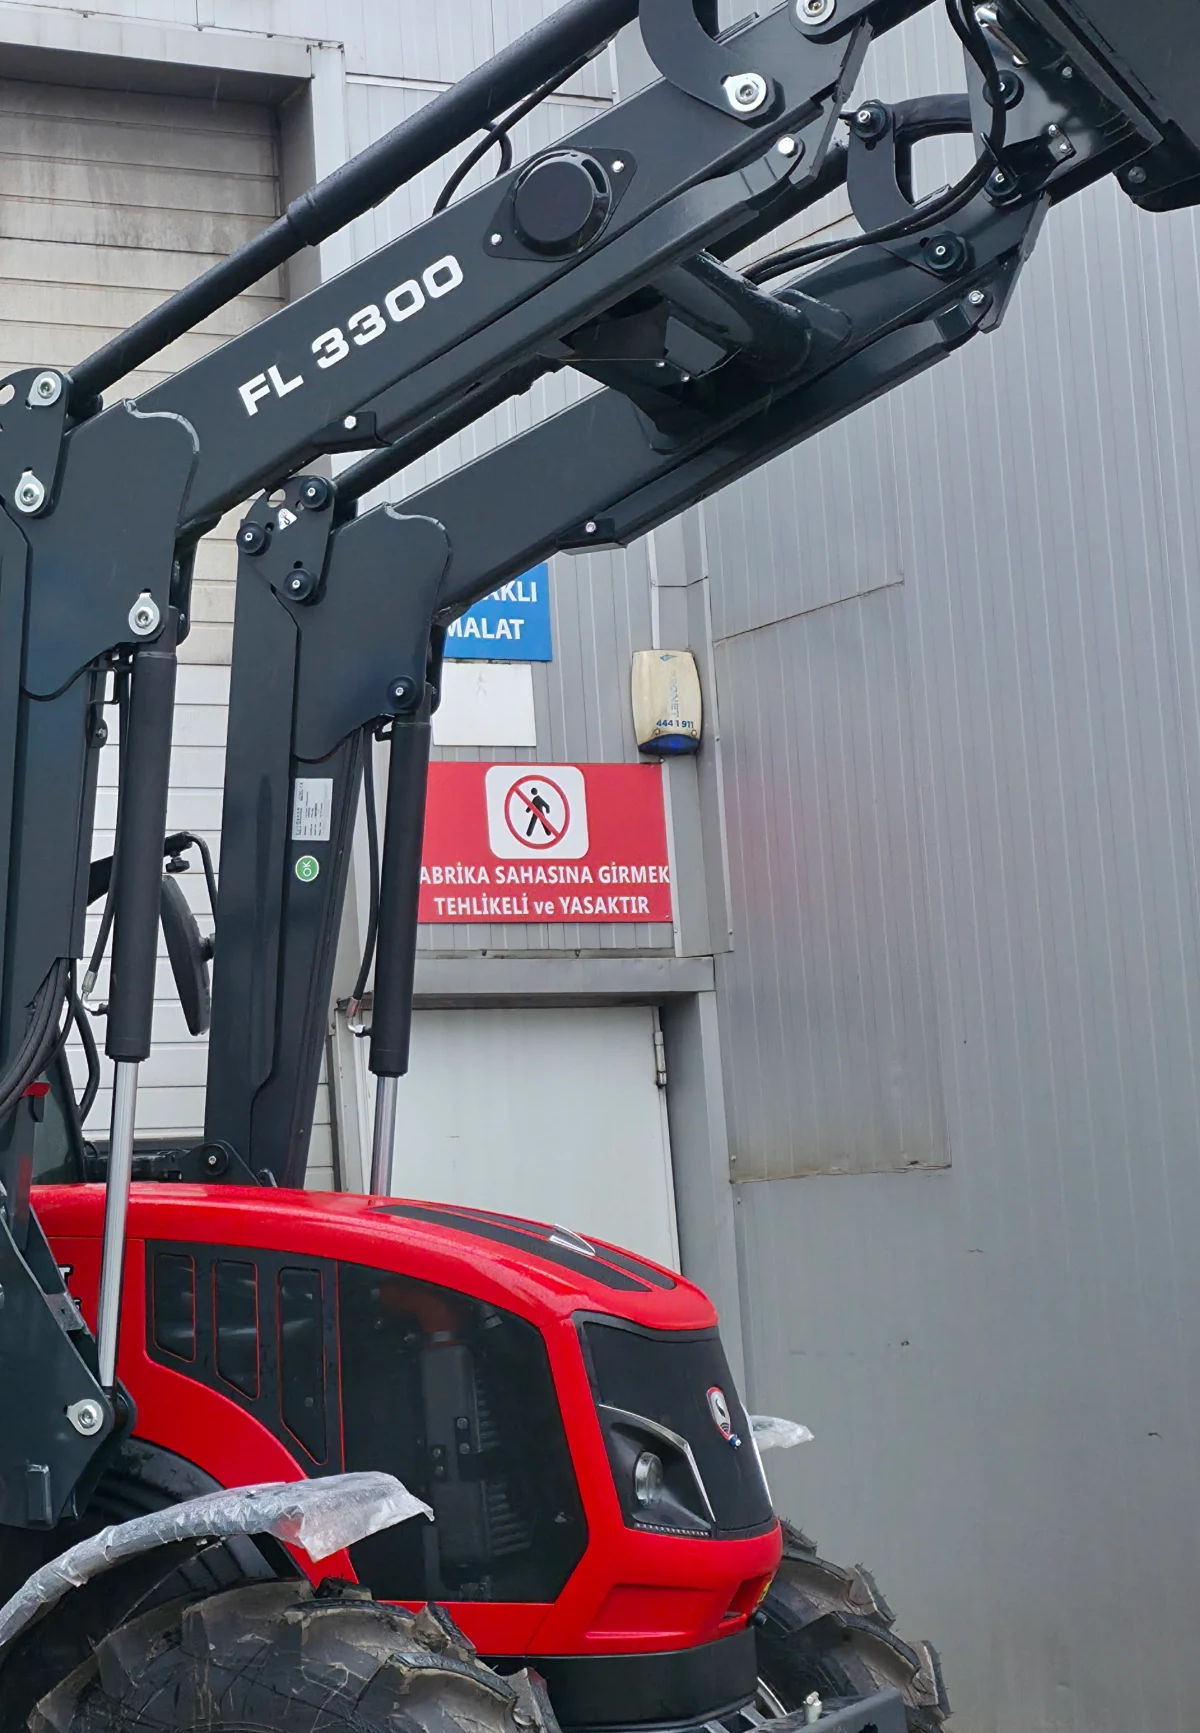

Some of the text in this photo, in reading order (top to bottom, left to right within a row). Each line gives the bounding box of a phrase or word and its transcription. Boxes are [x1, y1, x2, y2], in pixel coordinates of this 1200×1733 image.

[238, 254, 464, 417] FL 3300
[447, 617, 525, 640] MALAT
[303, 860, 312, 877] OK
[420, 861, 670, 885] ABRİKA SAHASINA GİRMEK
[434, 892, 651, 915] TEHLİKELİ ve YASAKTIR
